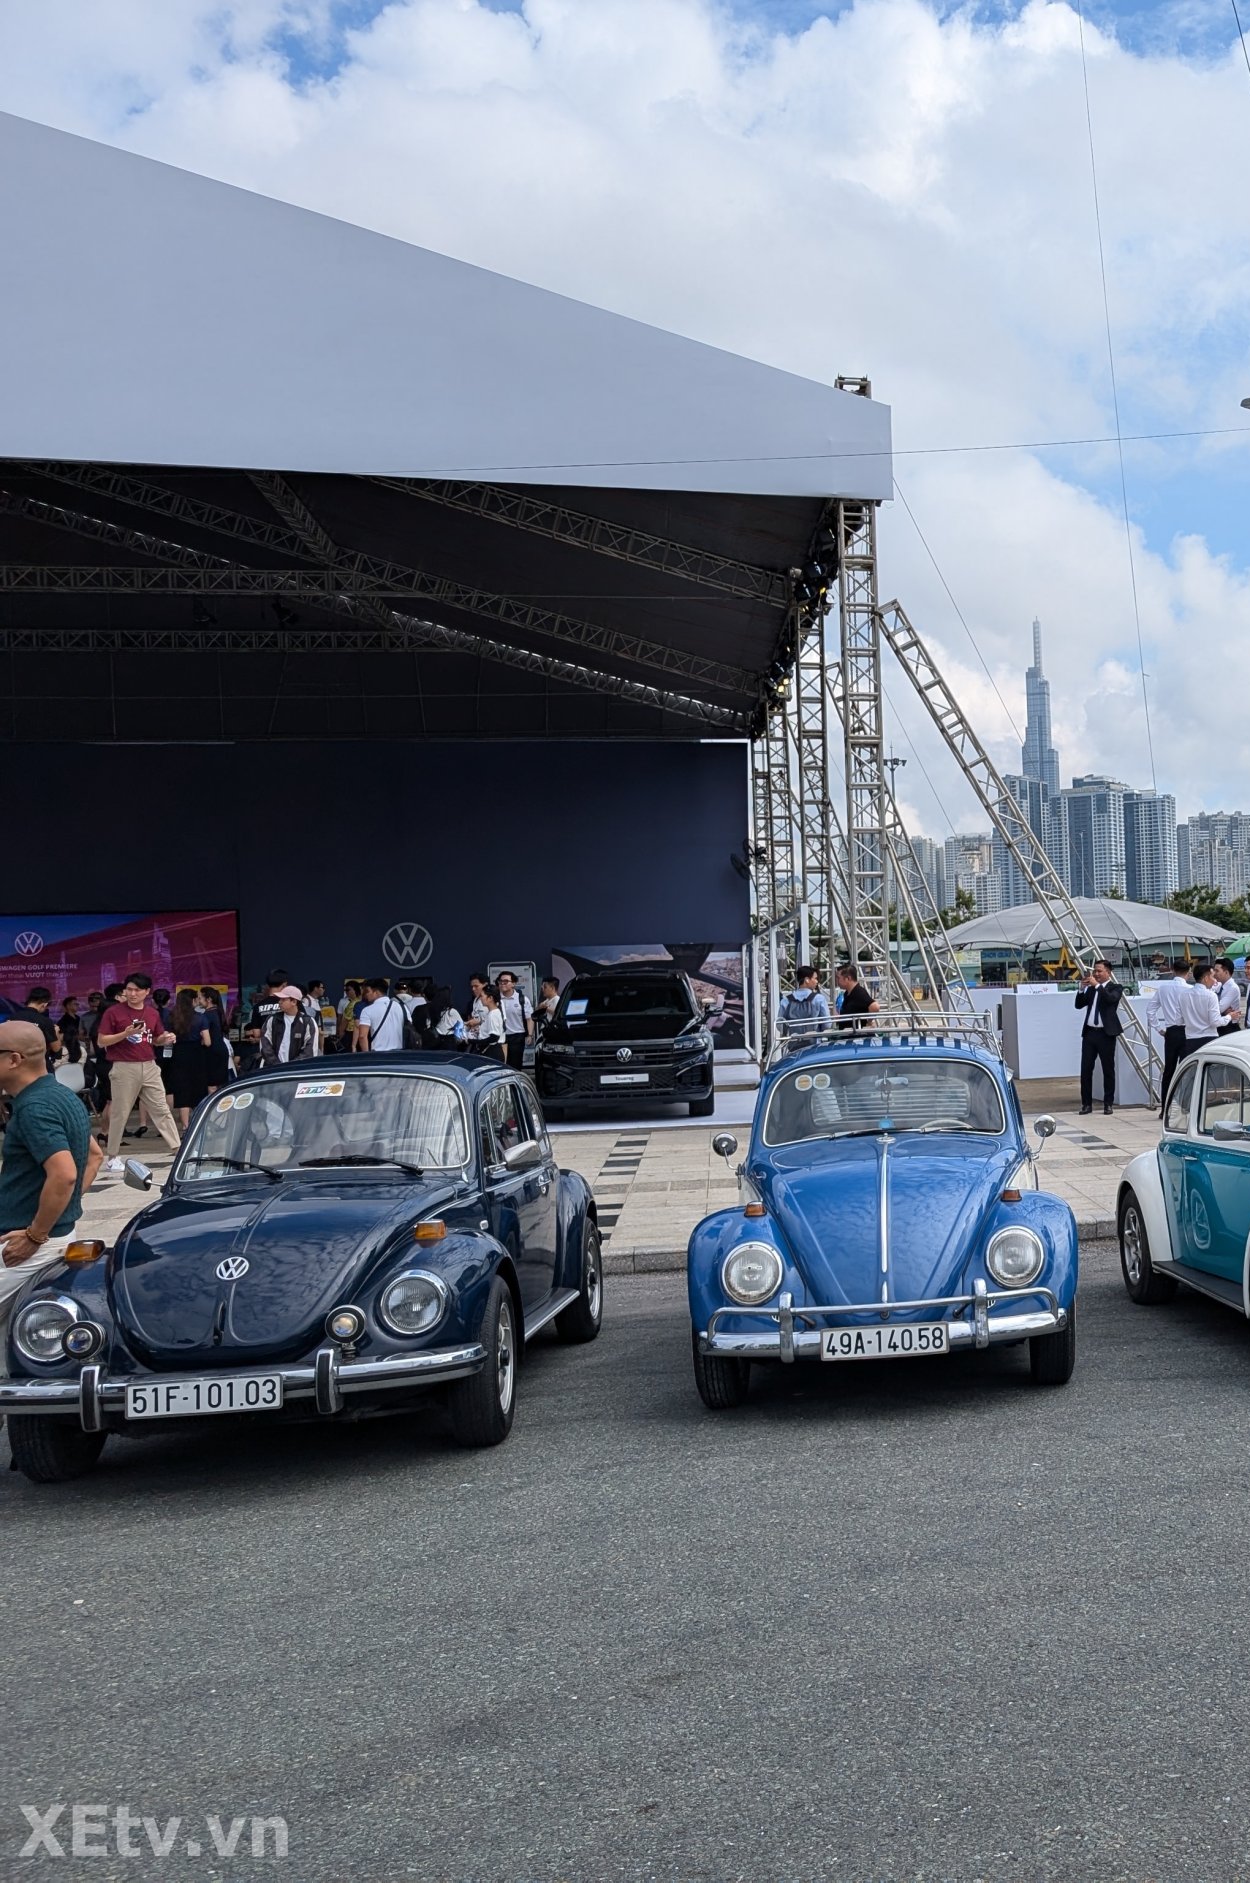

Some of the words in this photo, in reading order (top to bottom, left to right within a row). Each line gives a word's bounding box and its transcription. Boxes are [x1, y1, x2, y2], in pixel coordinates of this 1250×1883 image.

[382, 922, 433, 969] VW
[826, 1326, 944, 1356] 49A-140.58
[132, 1378, 277, 1414] 51F-101.03
